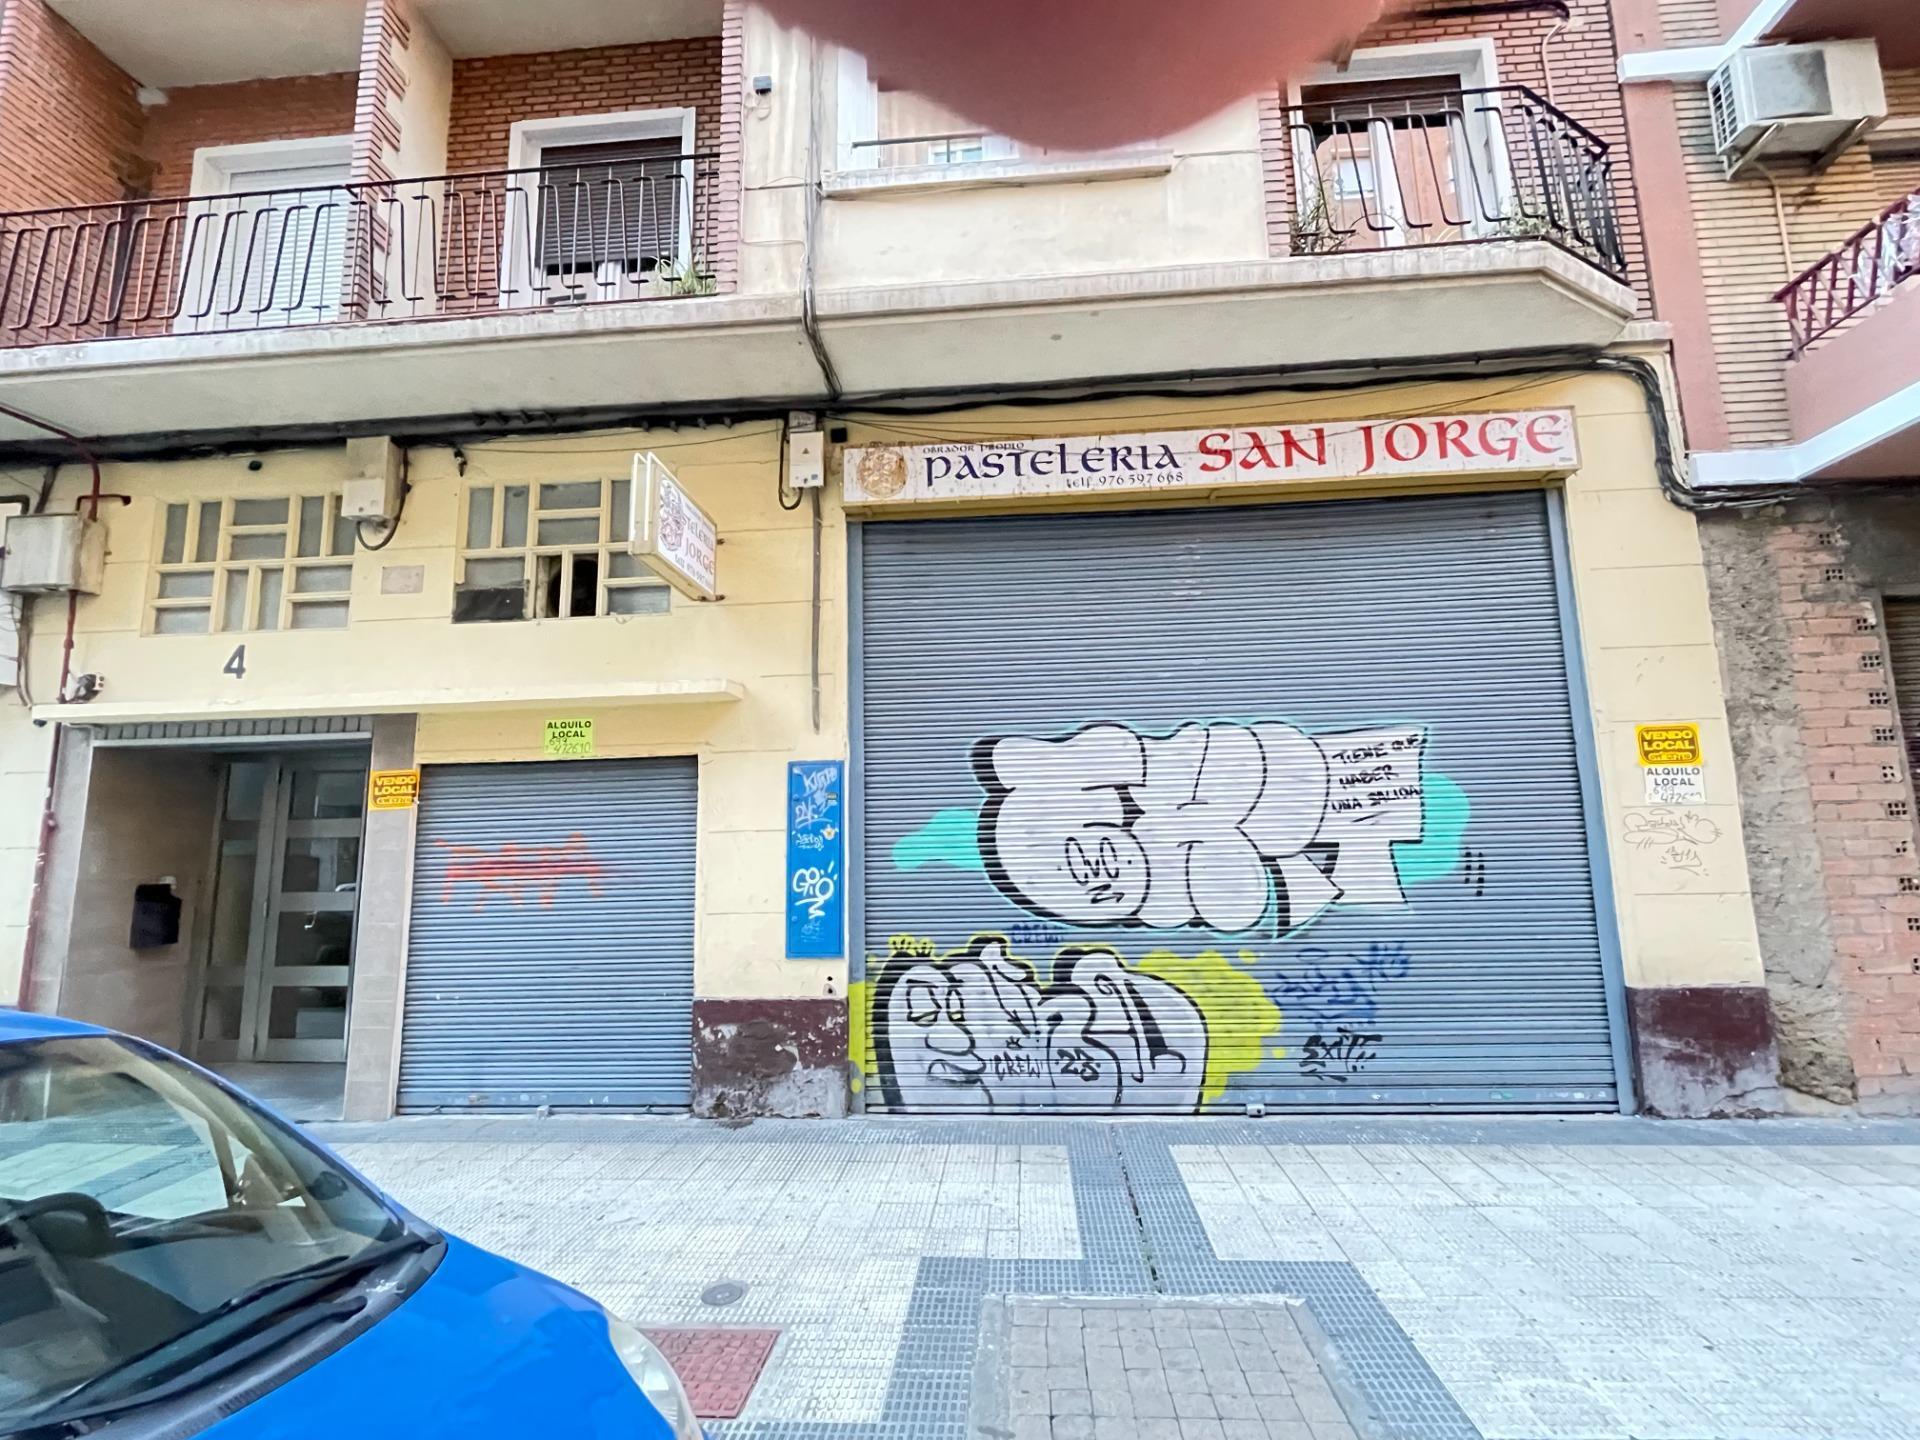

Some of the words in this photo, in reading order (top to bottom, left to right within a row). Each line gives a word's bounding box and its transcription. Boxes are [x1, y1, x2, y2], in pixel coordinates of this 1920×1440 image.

[1199, 428, 1327, 472] SAN
[1356, 414, 1564, 475] JORGE
[924, 444, 1182, 488] PASTELERIA
[222, 644, 247, 680] 4
[547, 720, 592, 729] ALQUILO
[552, 730, 586, 739] LOCAL
[1642, 730, 1693, 740] VENDO
[1643, 740, 1695, 750] LOCAL
[1332, 743, 1388, 764] TIENE
[1646, 767, 1701, 776] ALQUILO
[375, 776, 416, 786] VENDO
[1654, 778, 1695, 786] LOCAL
[374, 785, 416, 796] LOCAL
[1331, 798, 1363, 813] UNA
